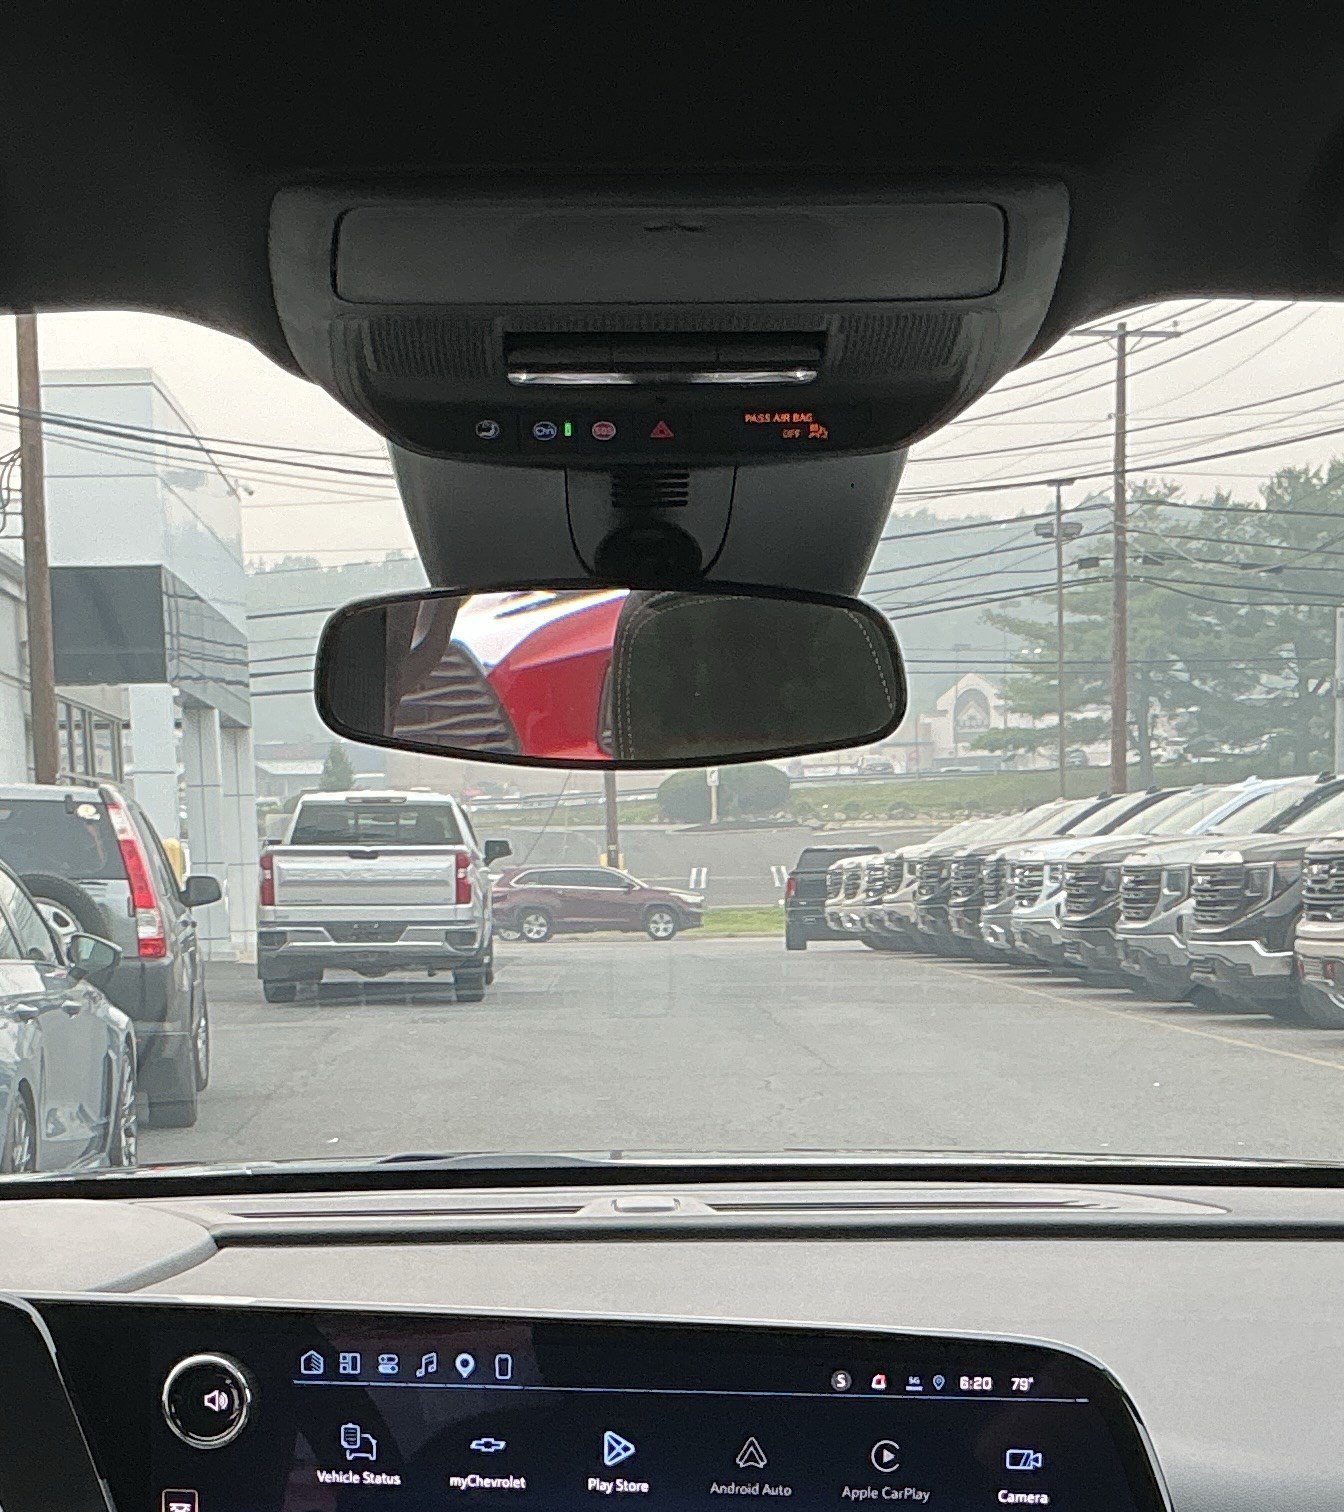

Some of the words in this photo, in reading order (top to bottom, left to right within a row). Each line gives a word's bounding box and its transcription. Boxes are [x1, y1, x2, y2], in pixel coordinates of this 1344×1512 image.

[744, 413, 771, 423] PASS
[773, 413, 791, 423] AIR
[793, 413, 813, 423] BAG
[958, 1375, 994, 1391] 6:20
[316, 1469, 360, 1485] Vehicle
[361, 1471, 402, 1486] Status
[449, 1474, 526, 1491] myChevrolet
[587, 1478, 614, 1493] Play
[615, 1479, 649, 1493] Store
[709, 1481, 760, 1496] Android
[761, 1483, 792, 1497] Auto
[841, 1486, 879, 1502] Apple
[881, 1487, 931, 1503] CarPlay
[997, 1490, 1050, 1505] Camera
